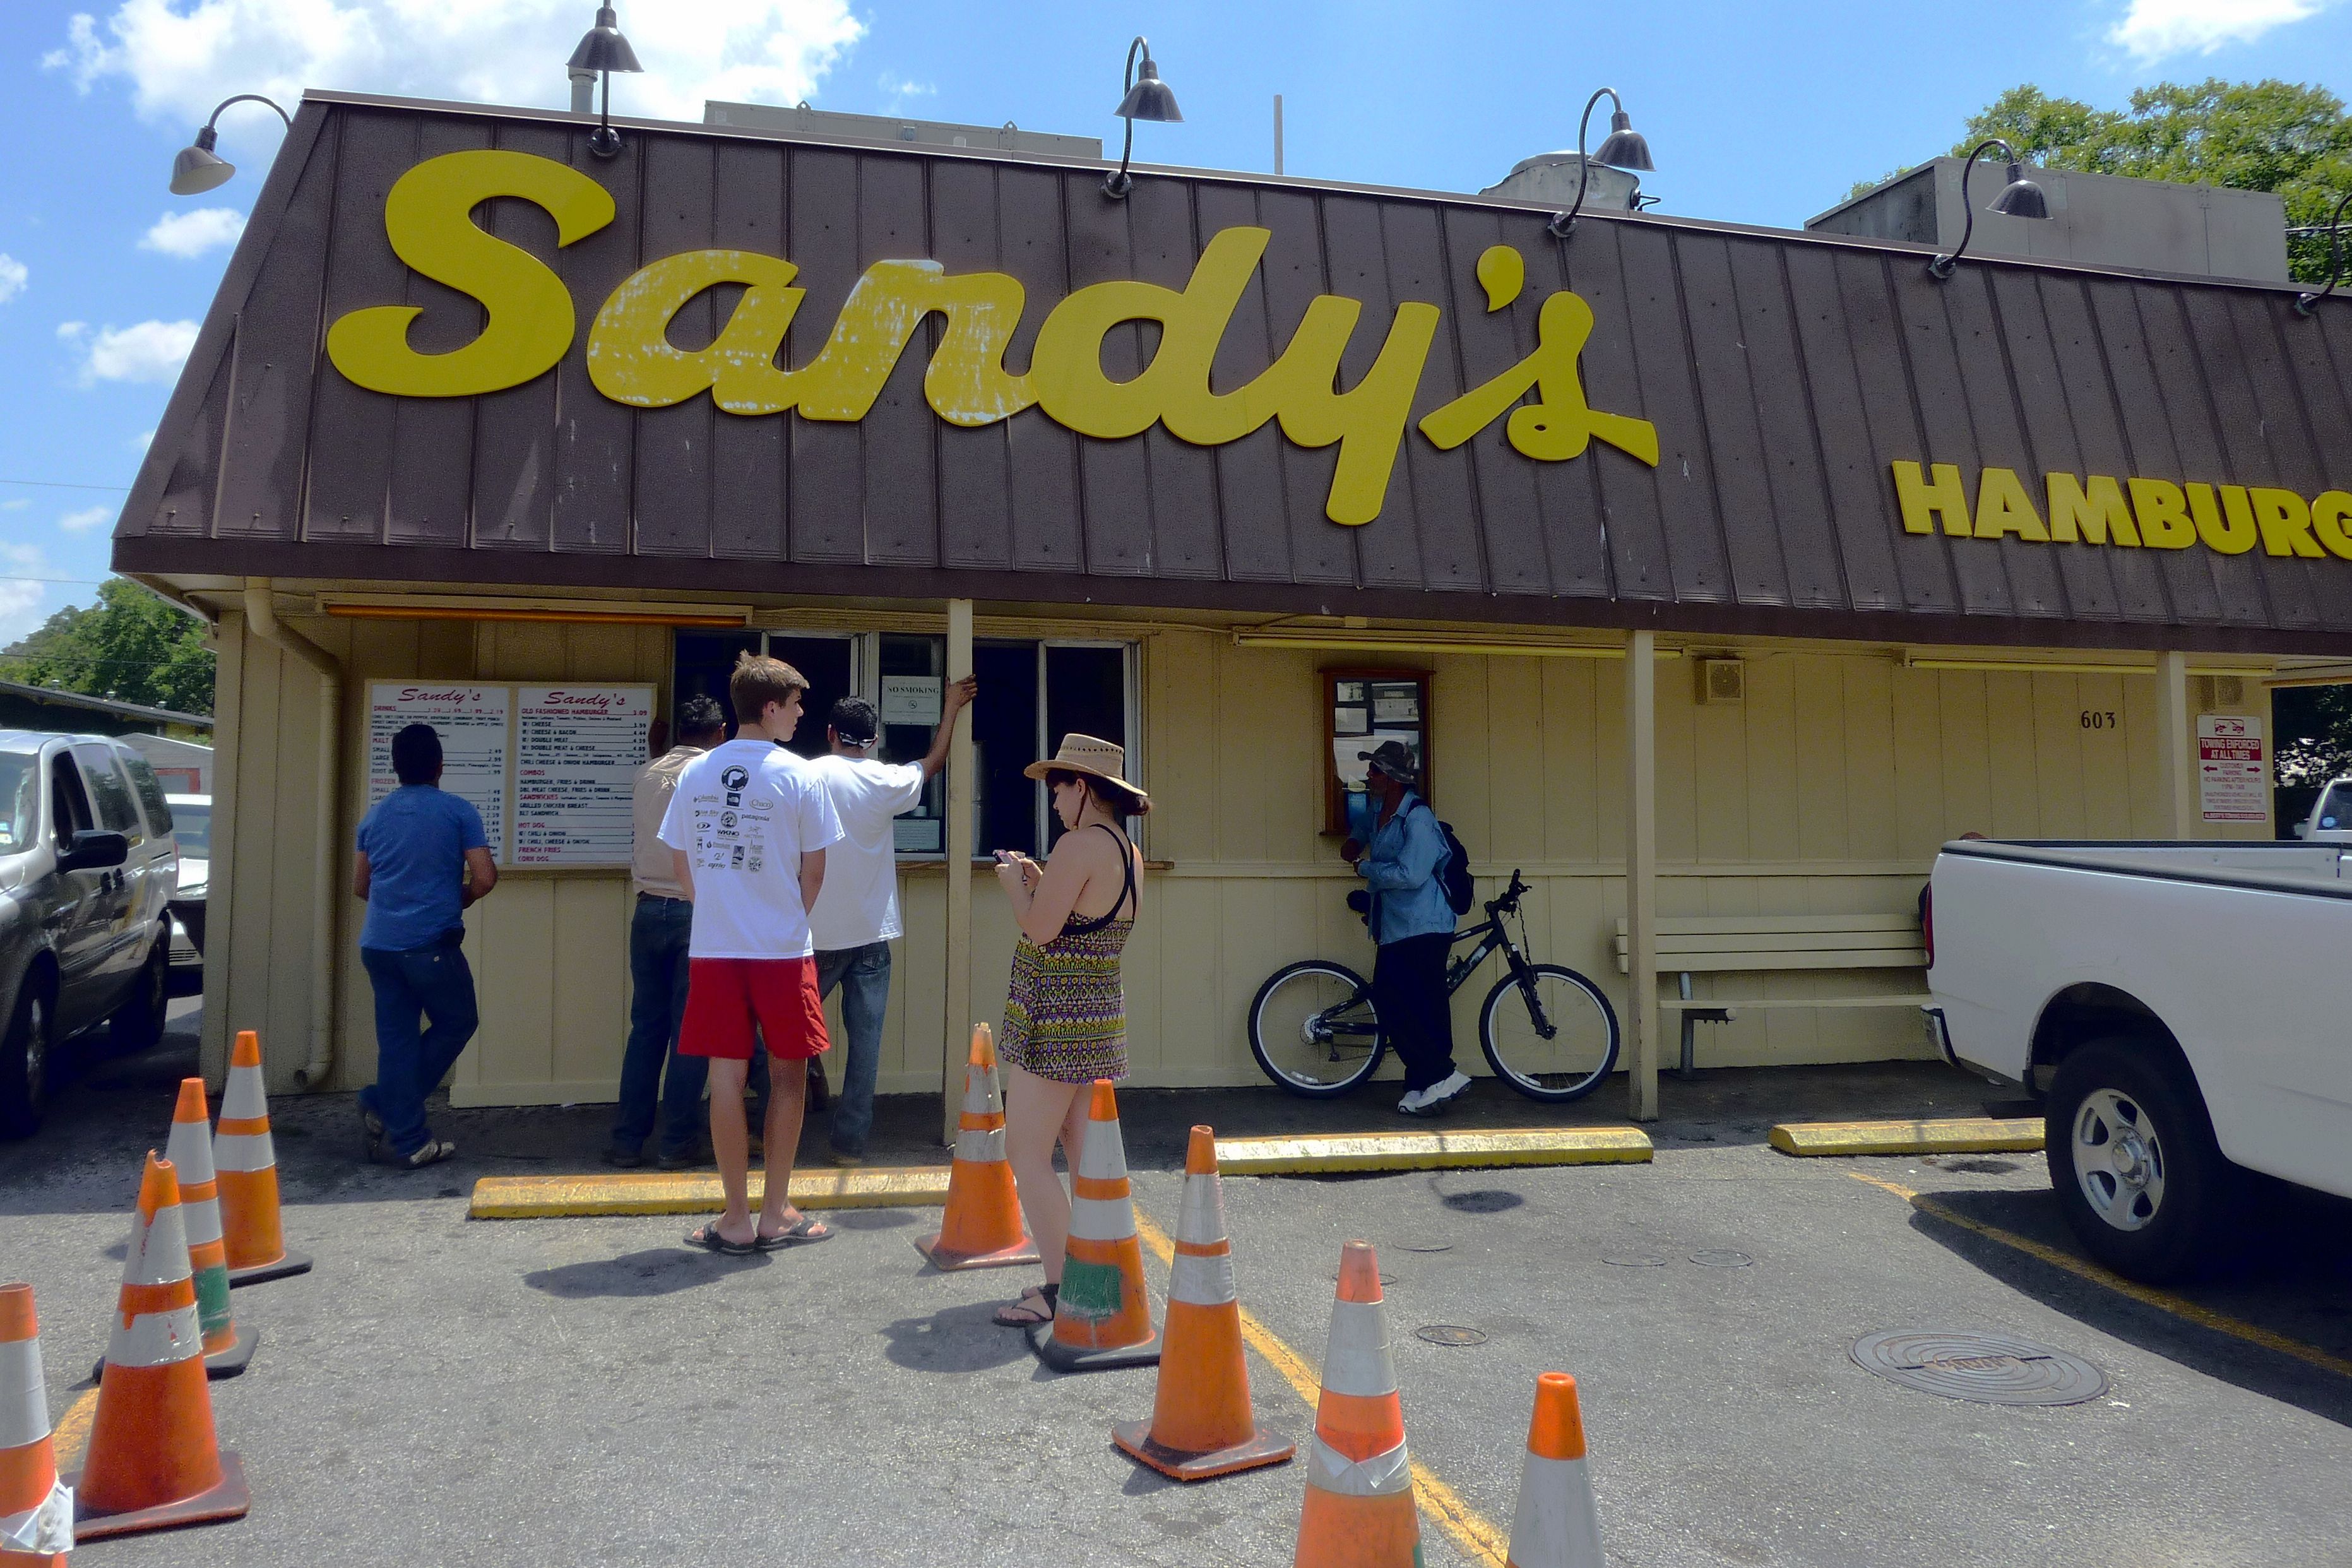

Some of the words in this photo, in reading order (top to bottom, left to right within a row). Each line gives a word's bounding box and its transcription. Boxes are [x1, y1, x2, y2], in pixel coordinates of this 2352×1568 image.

[326, 150, 1660, 526] Sandy's
[397, 689, 482, 704] Sandy's
[544, 692, 626, 708] Sandy's
[2081, 710, 2115, 728] 603
[2201, 739, 2226, 749] TOWING
[2226, 740, 2260, 749] ENFORCED
[2211, 750, 2219, 759] AT
[2219, 750, 2231, 759] ALL
[2231, 750, 2250, 759] TIMES
